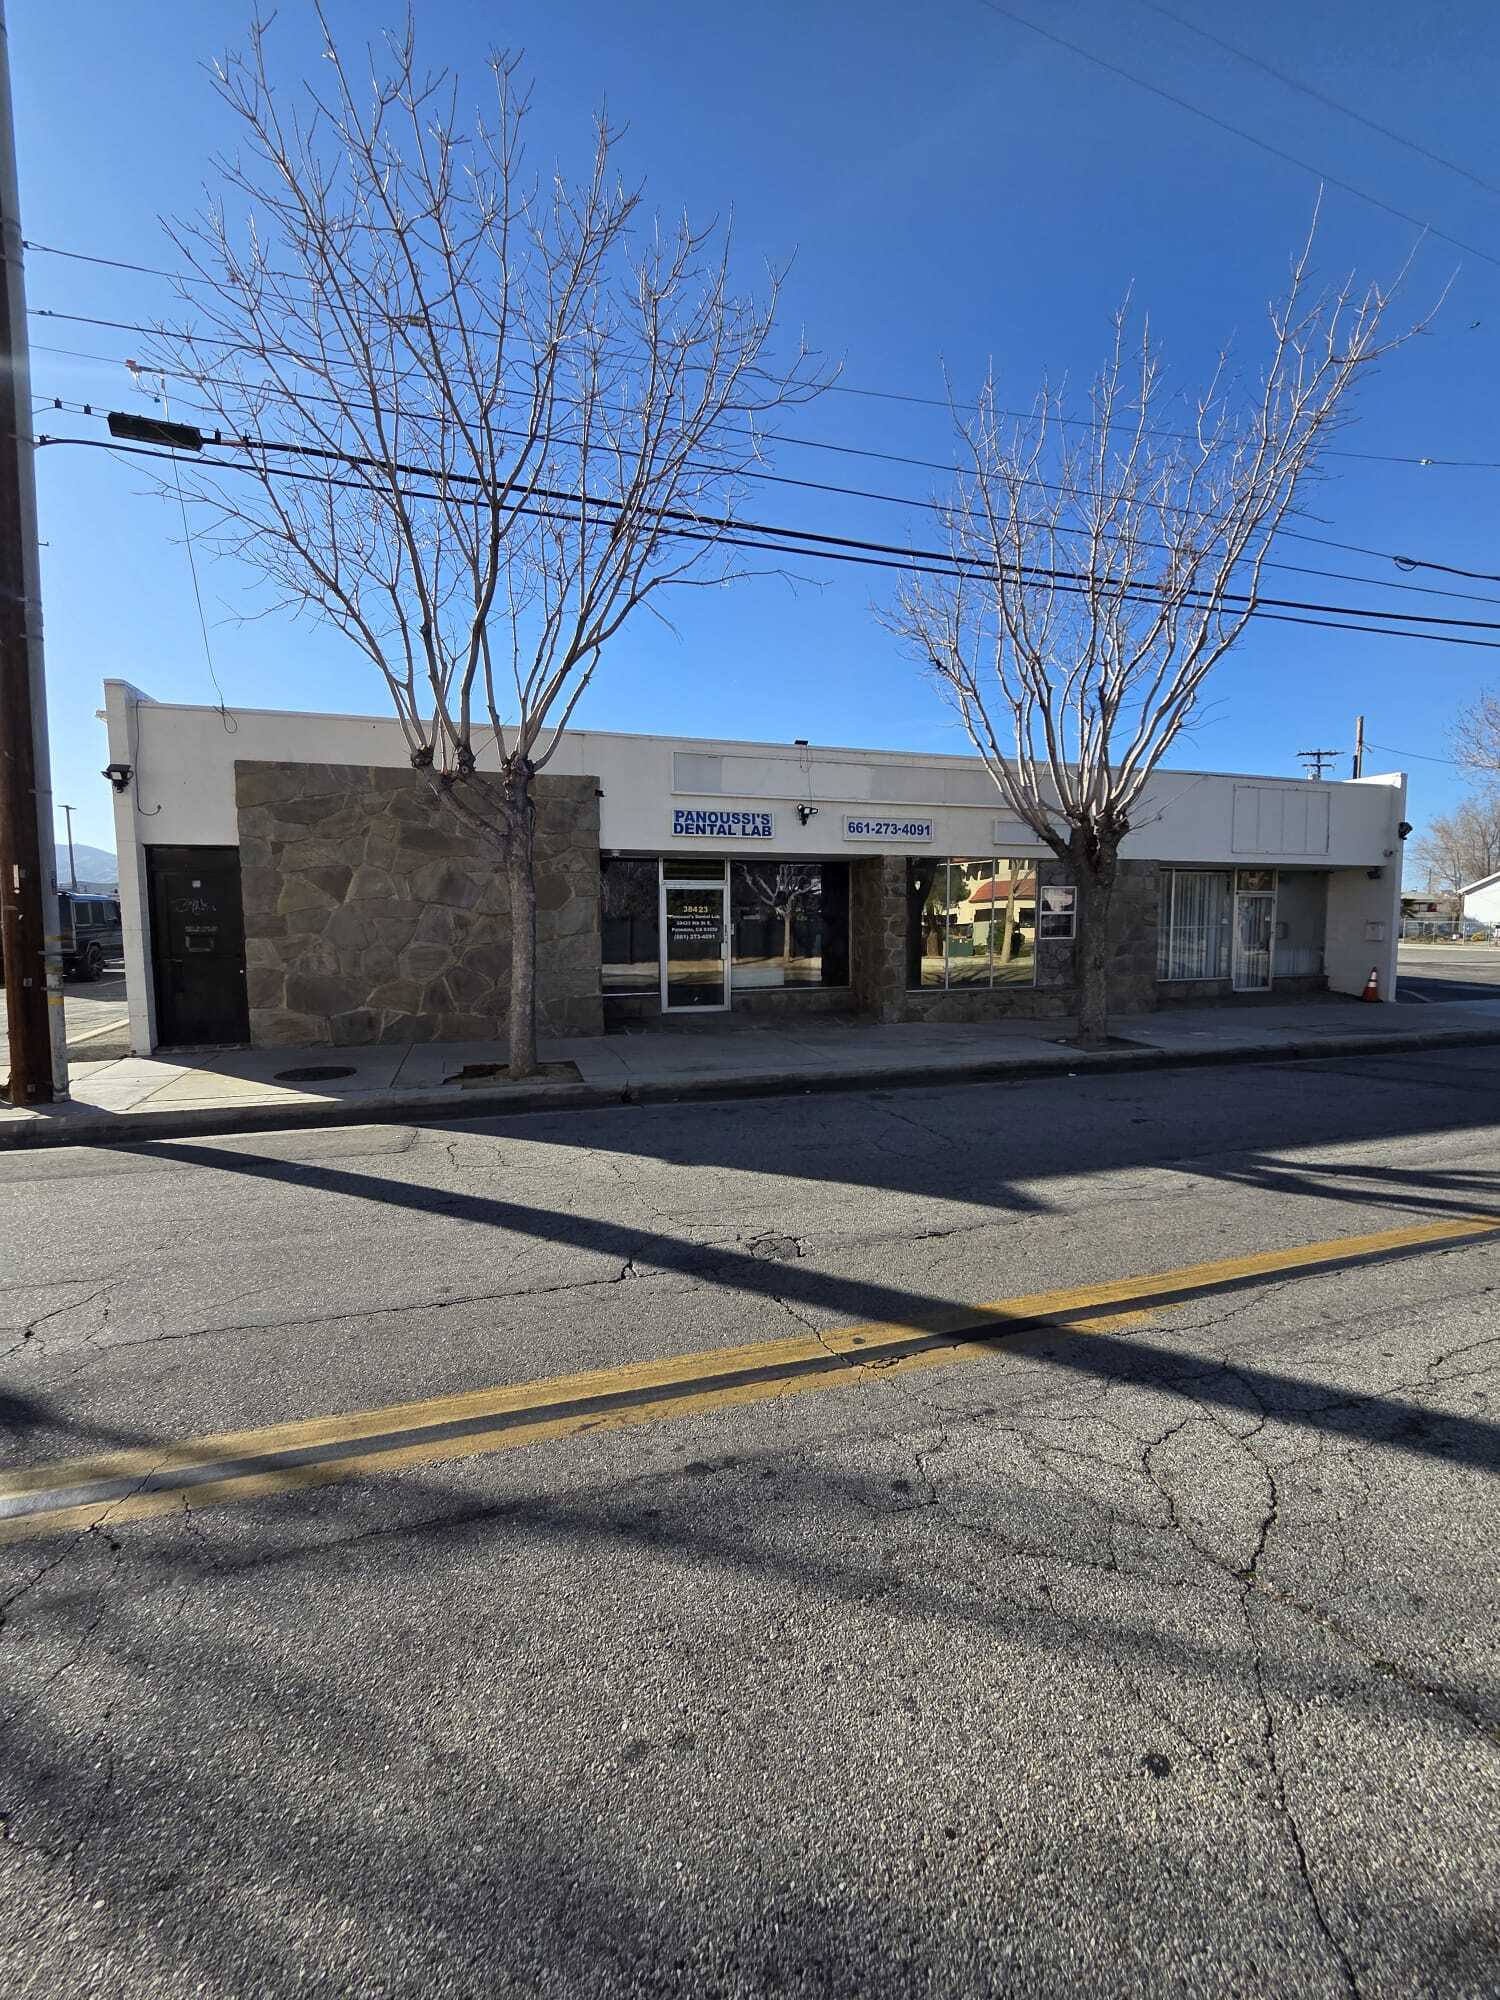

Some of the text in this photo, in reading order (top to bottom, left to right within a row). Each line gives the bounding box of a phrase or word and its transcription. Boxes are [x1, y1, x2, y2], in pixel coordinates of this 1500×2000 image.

[675, 810, 771, 825] PANOUSSI'S
[673, 822, 772, 836] DENTAL LAB
[848, 822, 930, 836] 661-273-4091
[683, 905, 708, 913] 38423
